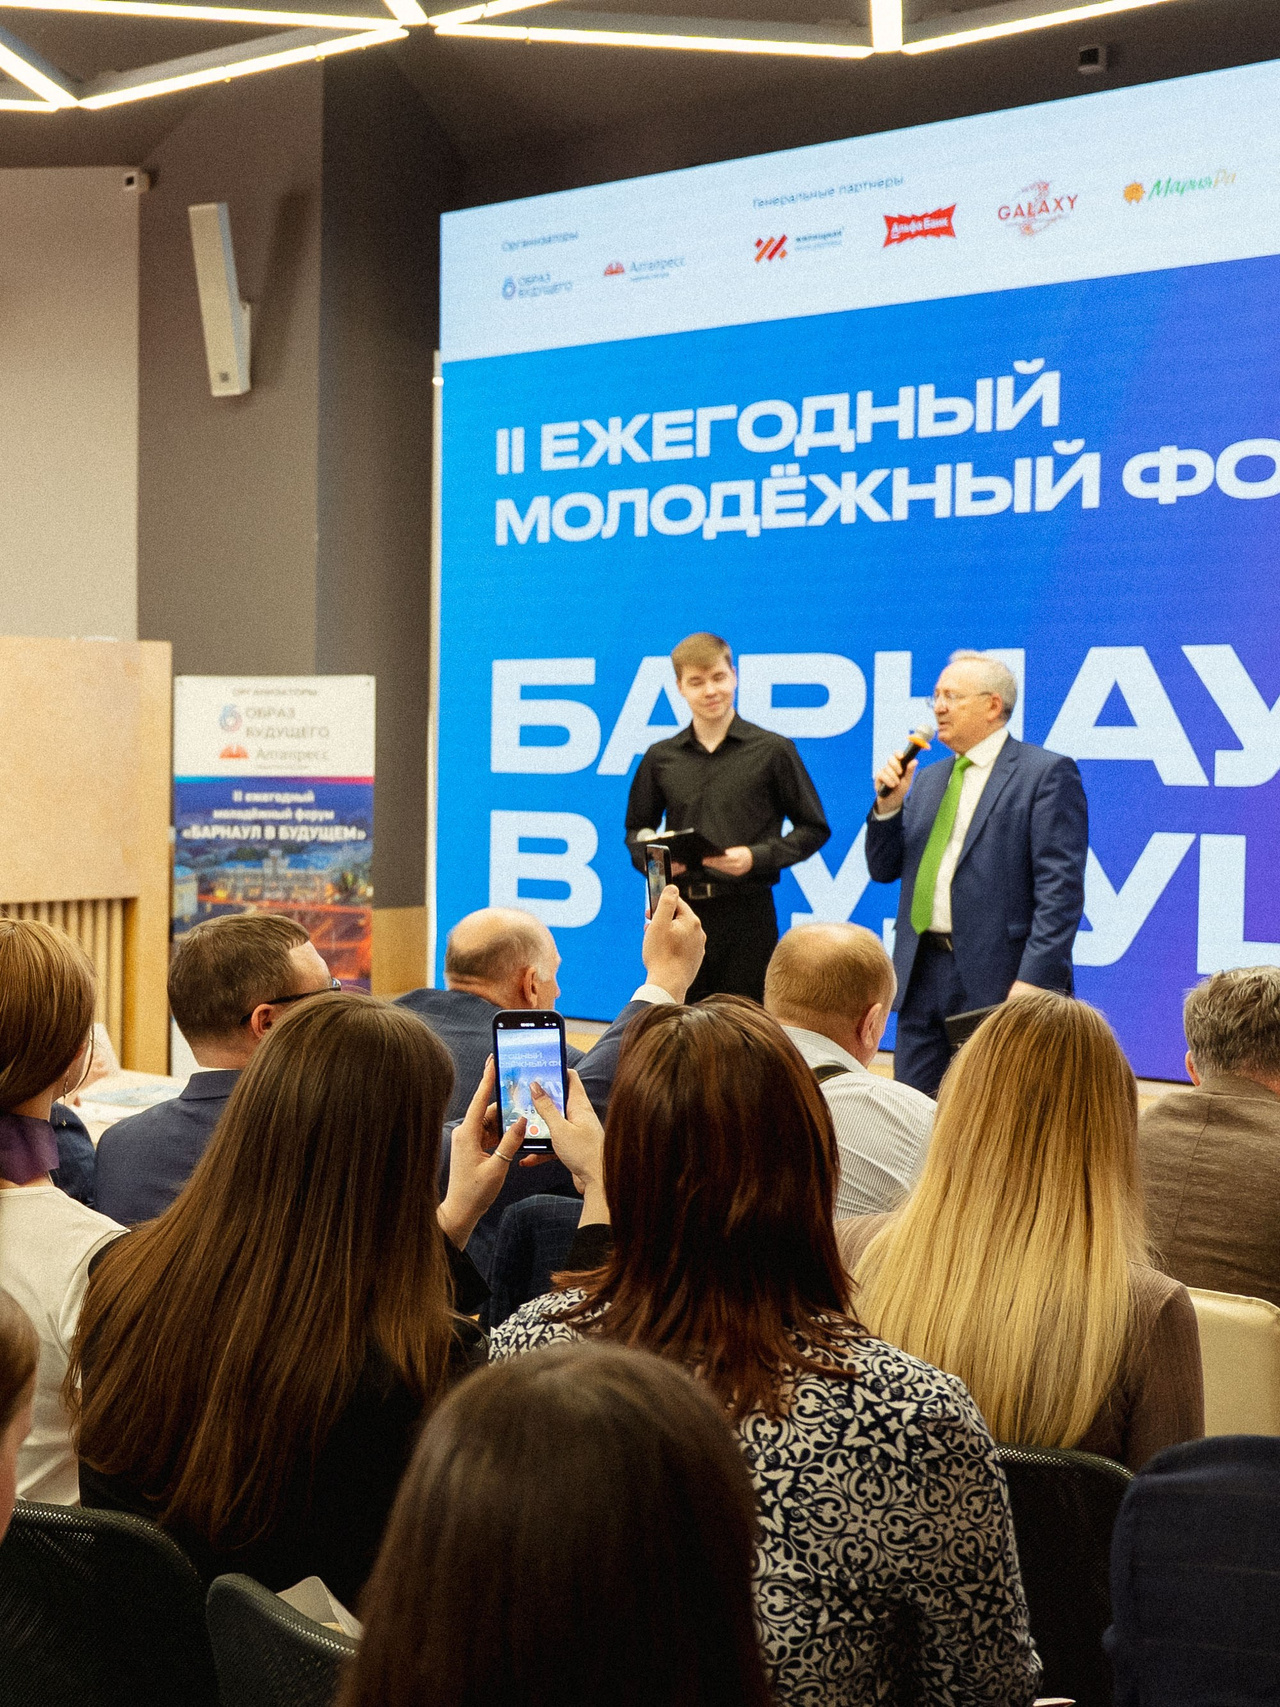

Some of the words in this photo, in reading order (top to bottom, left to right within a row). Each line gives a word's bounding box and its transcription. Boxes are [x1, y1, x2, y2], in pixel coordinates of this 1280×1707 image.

[997, 194, 1079, 222] GALAXY
[541, 358, 1062, 472] ЕЖЕГОДНЫЙ
[495, 440, 1101, 546] МОЛОДЁЖНЫЙ
[1122, 438, 1280, 505] ФО
[488, 810, 603, 928] В
